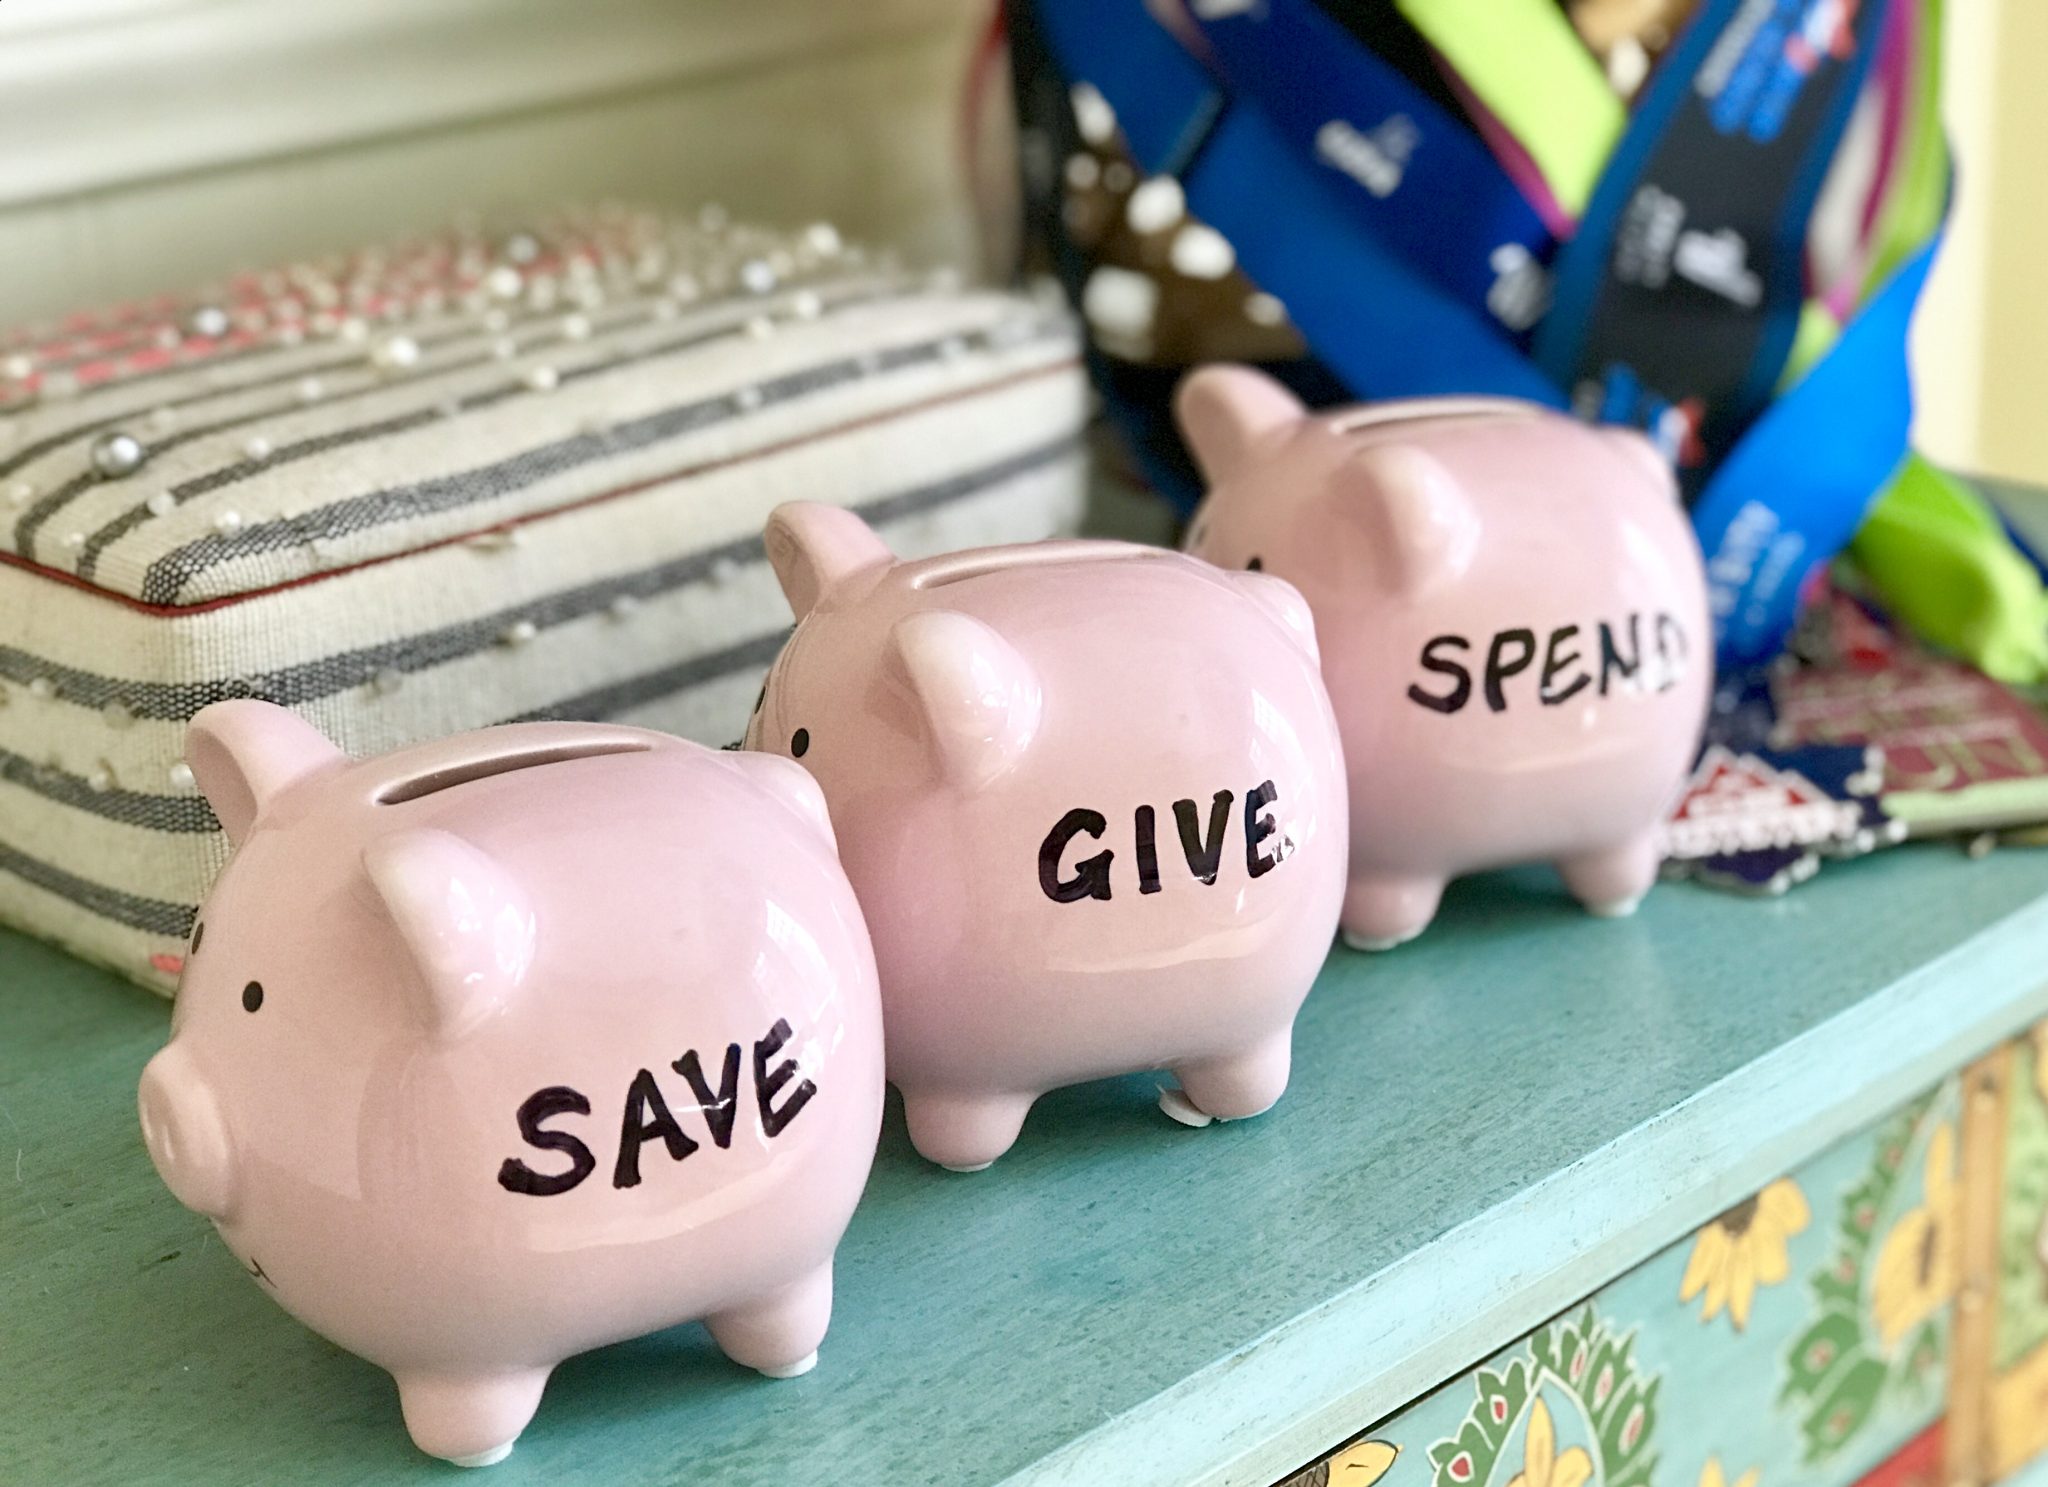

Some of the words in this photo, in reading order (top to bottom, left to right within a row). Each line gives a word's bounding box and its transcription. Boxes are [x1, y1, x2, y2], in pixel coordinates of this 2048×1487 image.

[1407, 610, 1690, 715] SPEND
[1037, 780, 1294, 903] GIVE
[497, 1017, 818, 1197] SAVE
